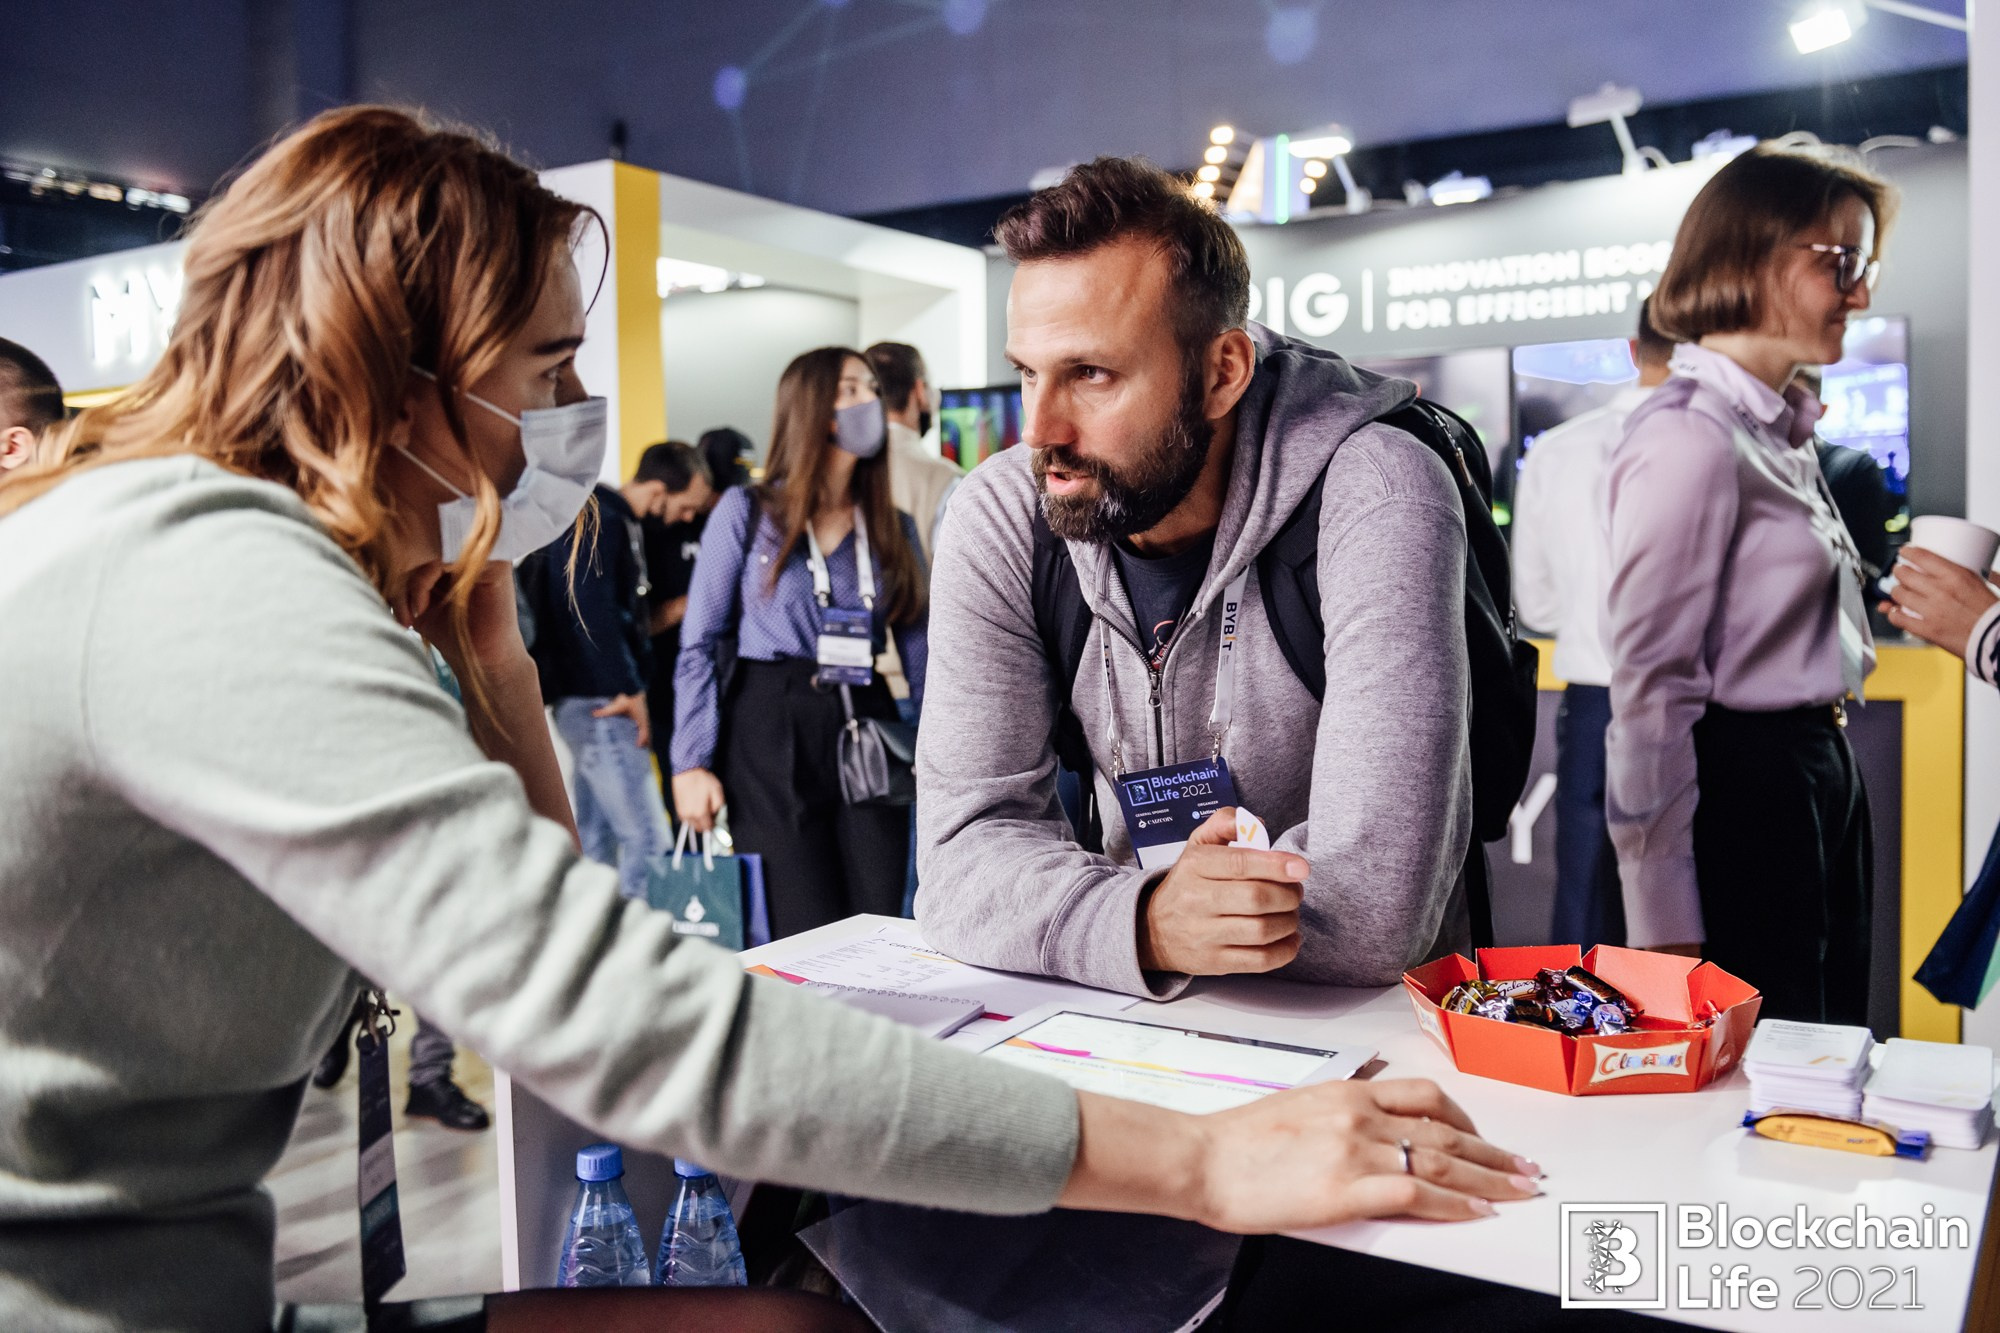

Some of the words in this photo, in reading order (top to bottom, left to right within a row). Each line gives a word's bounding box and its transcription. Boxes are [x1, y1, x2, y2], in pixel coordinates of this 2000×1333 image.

[1387, 250, 1580, 297] INNOVATION
[1250, 272, 1349, 338] IG
[1386, 298, 1451, 331] FOR
[1456, 280, 1631, 326] EFFICIENT
[1222, 602, 1237, 651] BYBIT
[1151, 768, 1219, 788] Blockchain
[1155, 790, 1180, 802] Life
[1181, 782, 1213, 798] 2021
[1497, 980, 1537, 998] Galaxy
